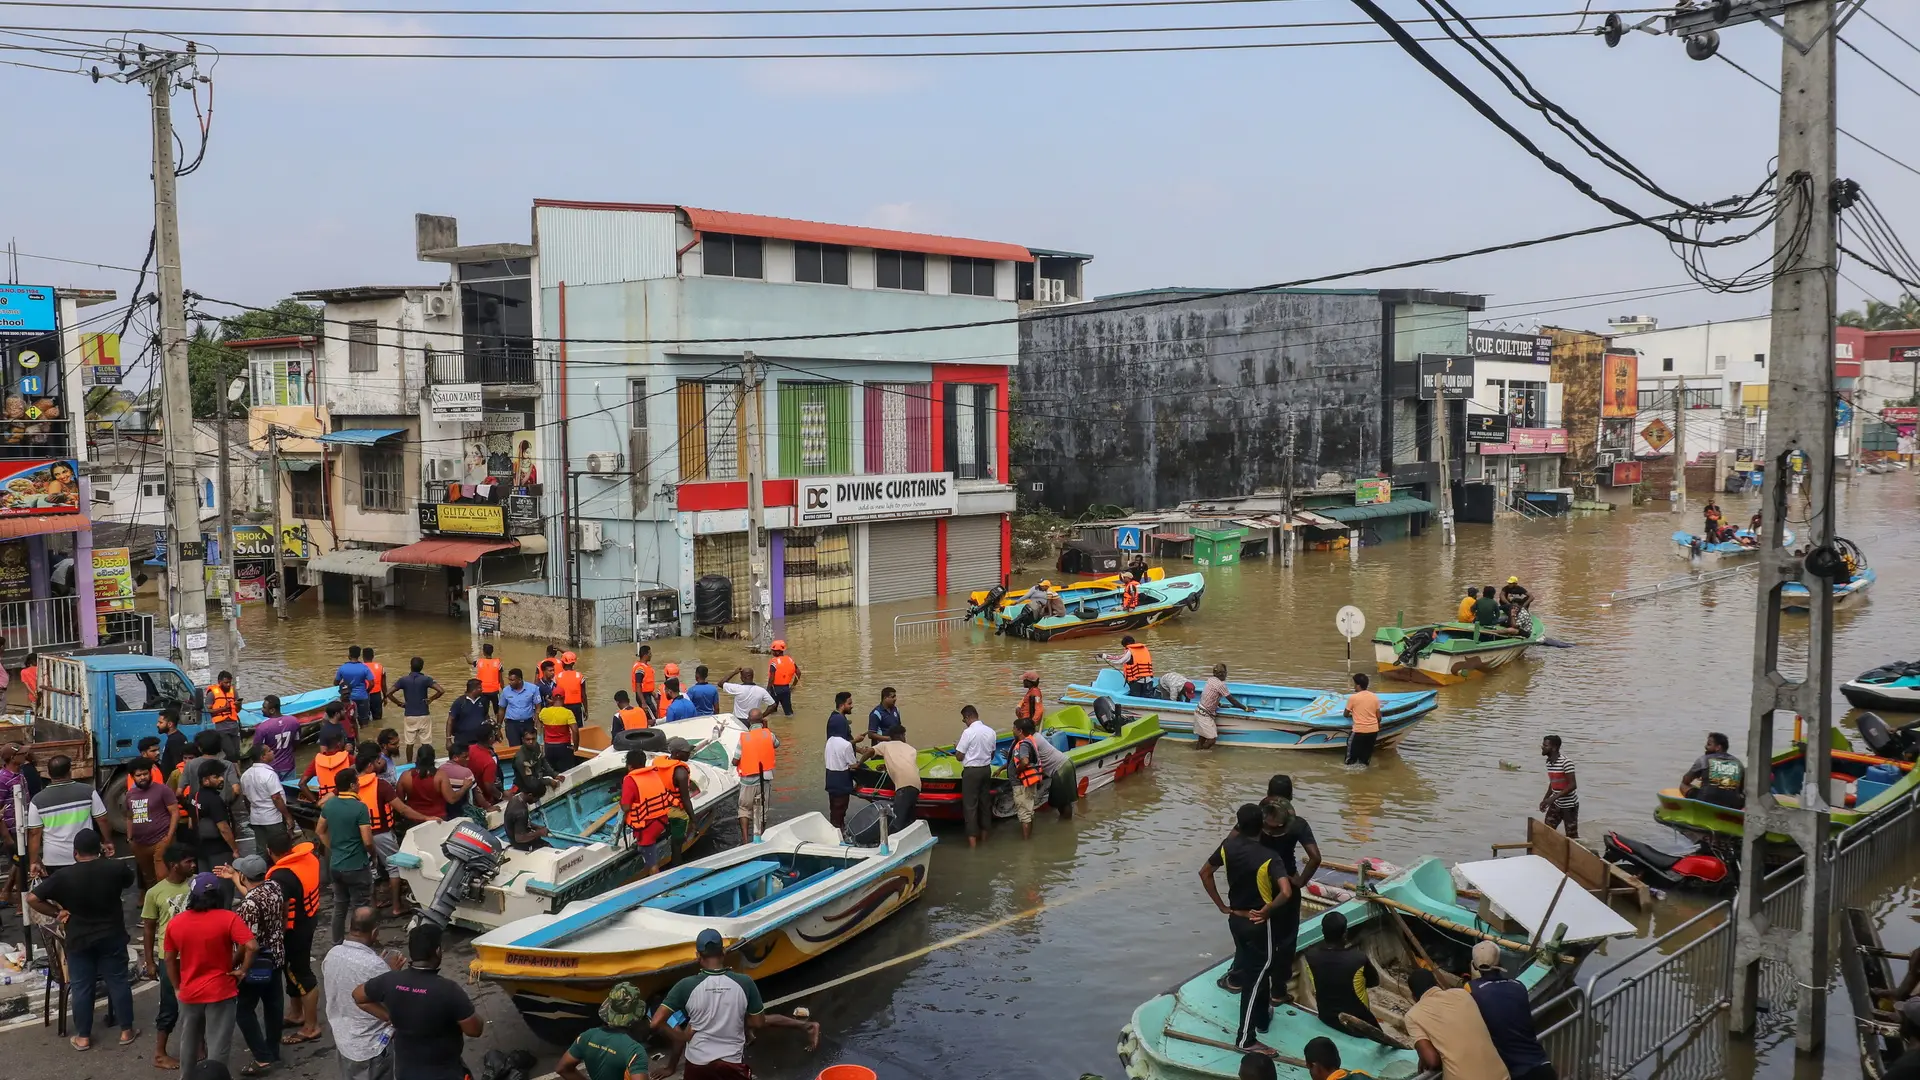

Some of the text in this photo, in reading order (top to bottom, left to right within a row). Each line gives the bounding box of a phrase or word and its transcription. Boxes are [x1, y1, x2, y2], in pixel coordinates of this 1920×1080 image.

[1475, 336, 1494, 354] CUE
[1495, 338, 1534, 357] CULTURE
[1423, 374, 1434, 387] THE
[1457, 375, 1473, 388] GRAND
[439, 391, 481, 402] SALON ZAMEE
[494, 413, 521, 423] Zamee
[806, 486, 829, 510] DC
[837, 479, 946, 502] DIVINE CURTAINS
[443, 506, 501, 518] GLITZ & GLAM
[274, 730, 291, 750] 17
[460, 826, 484, 842] YAMAHA
[560, 956, 576, 968] KLT
